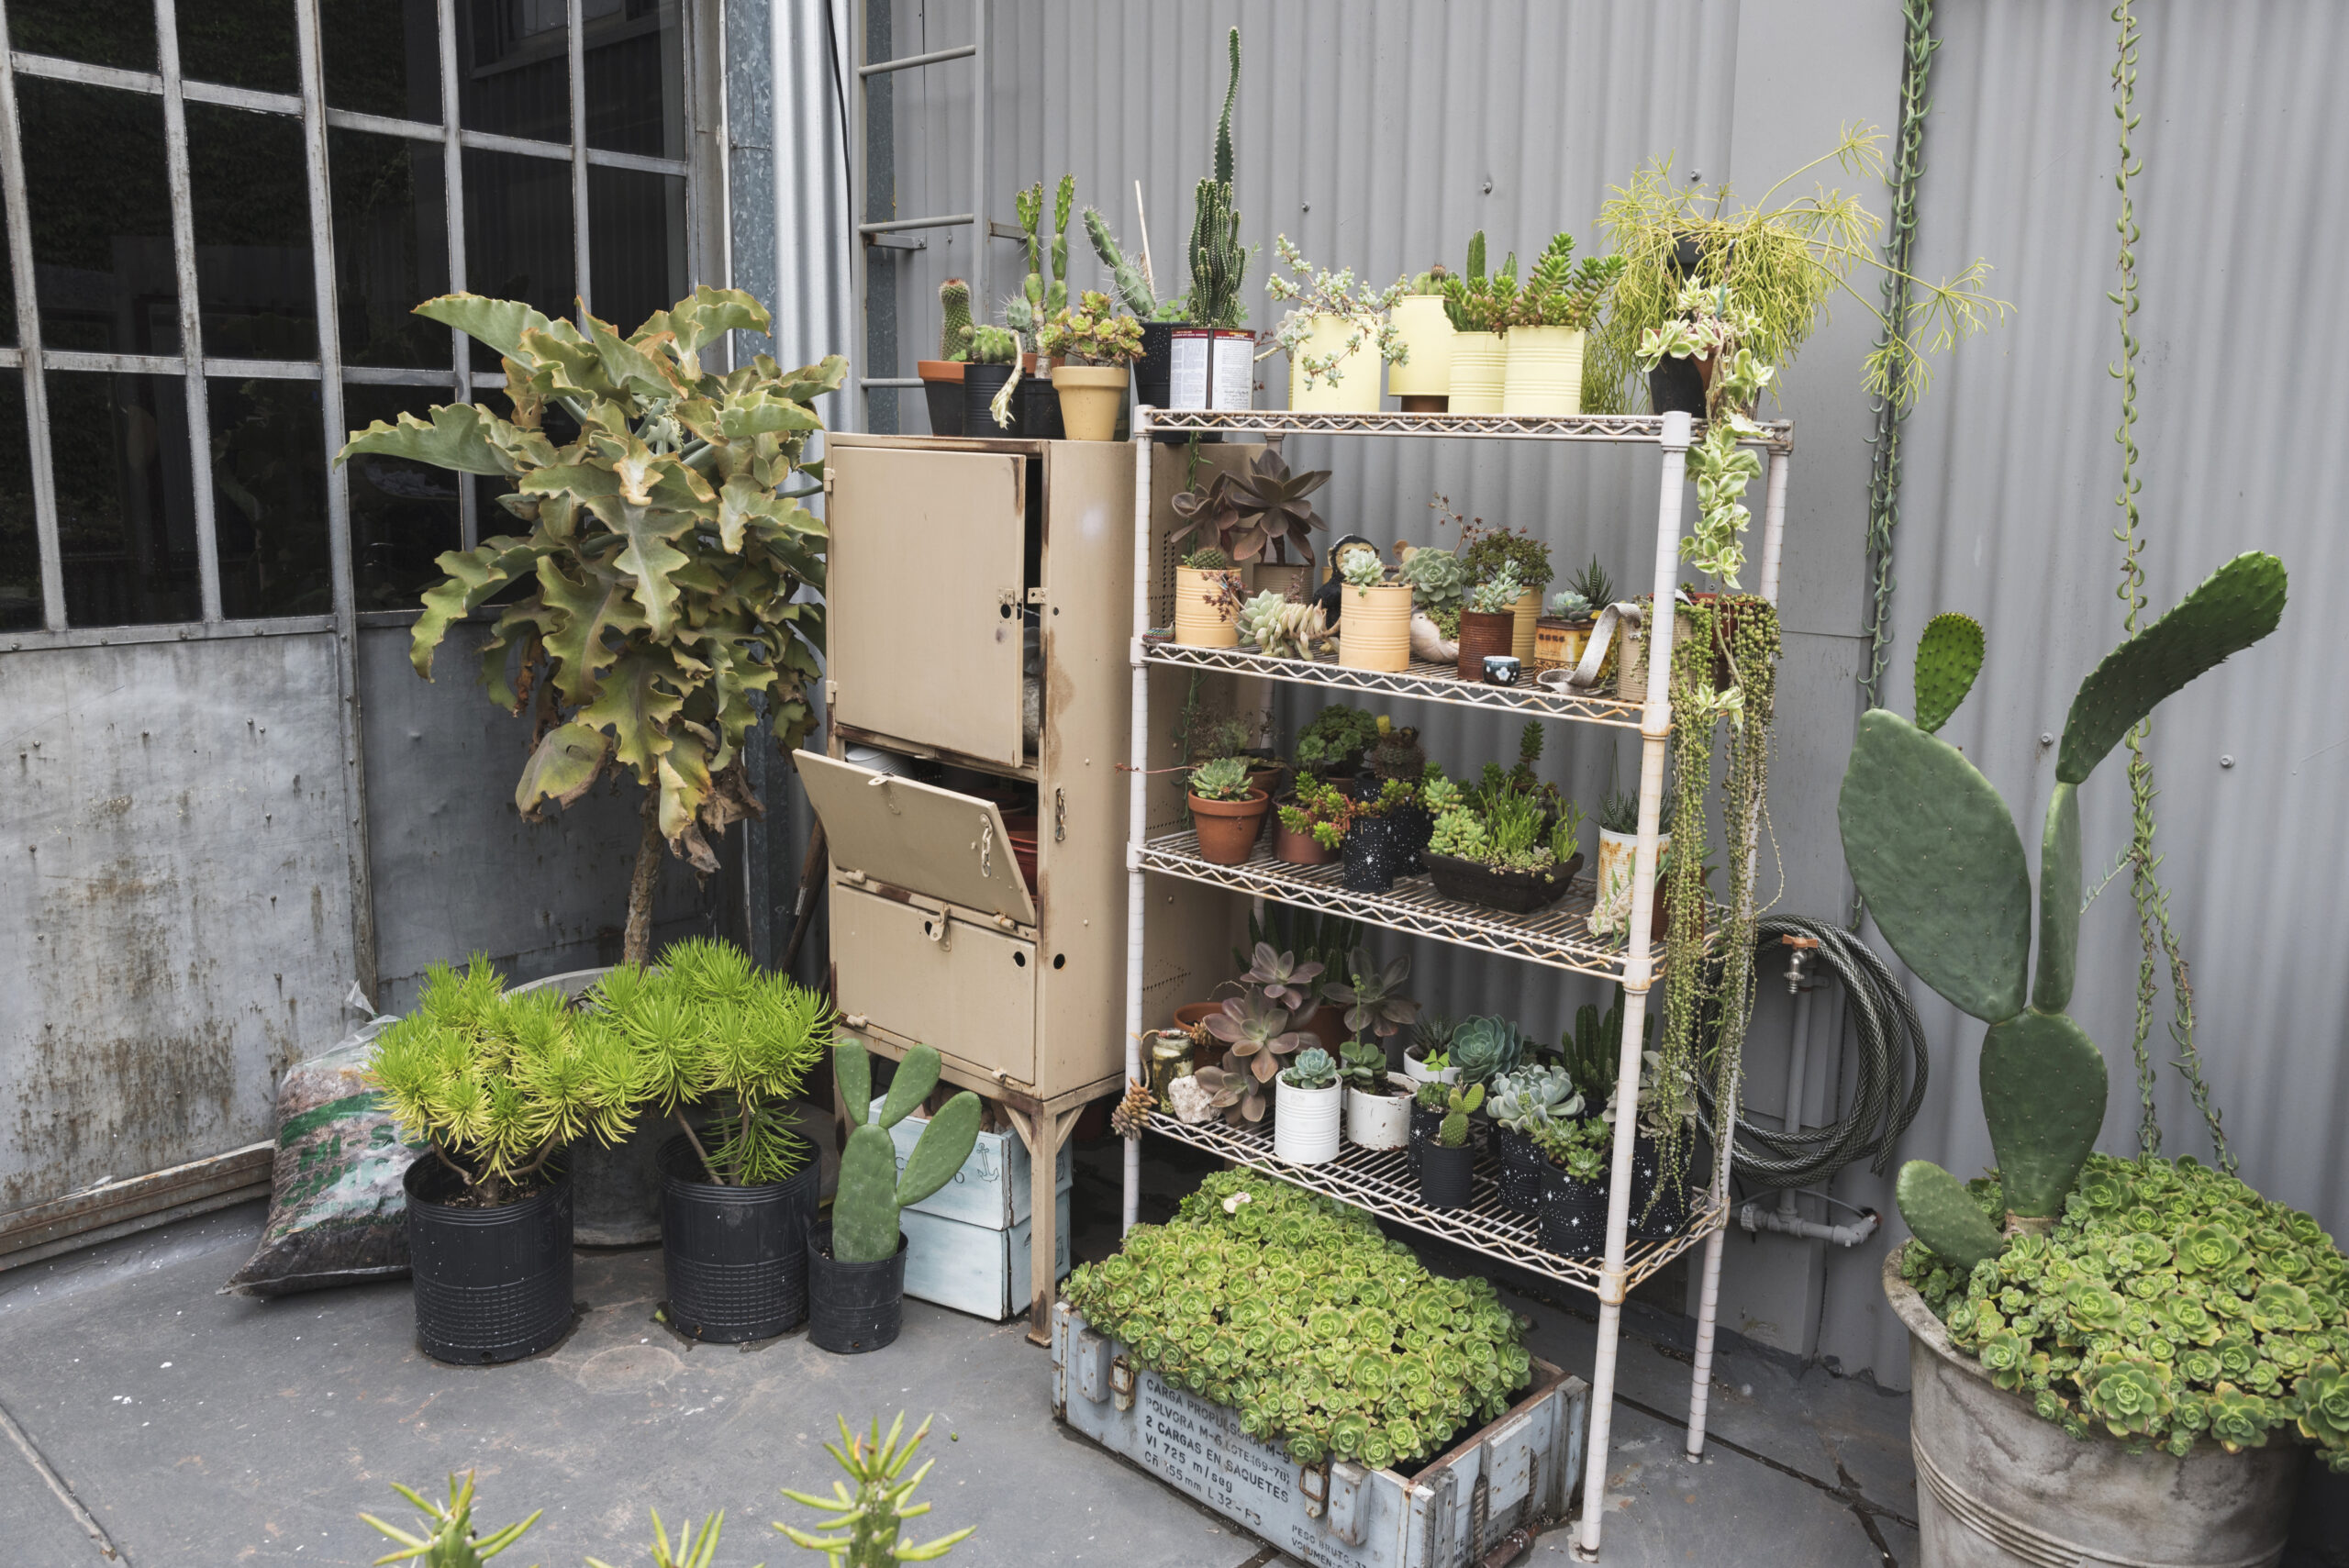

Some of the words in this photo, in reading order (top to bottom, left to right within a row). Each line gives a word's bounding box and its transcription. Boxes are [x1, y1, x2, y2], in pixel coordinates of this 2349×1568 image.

[1145, 1396, 1195, 1432] POLVORA
[1199, 1425, 1222, 1447] M-6
[1146, 1378, 1184, 1407] CARGA
[1186, 1399, 1261, 1449] PROPULSORA
[1265, 1444, 1291, 1464] M-9
[1145, 1415, 1153, 1428] 2
[1157, 1421, 1202, 1455] CARGAS
[1206, 1449, 1222, 1466] EN
[1225, 1459, 1289, 1504] SAQUETES
[1163, 1442, 1186, 1464] 725
[1291, 1523, 1316, 1544] PESO
